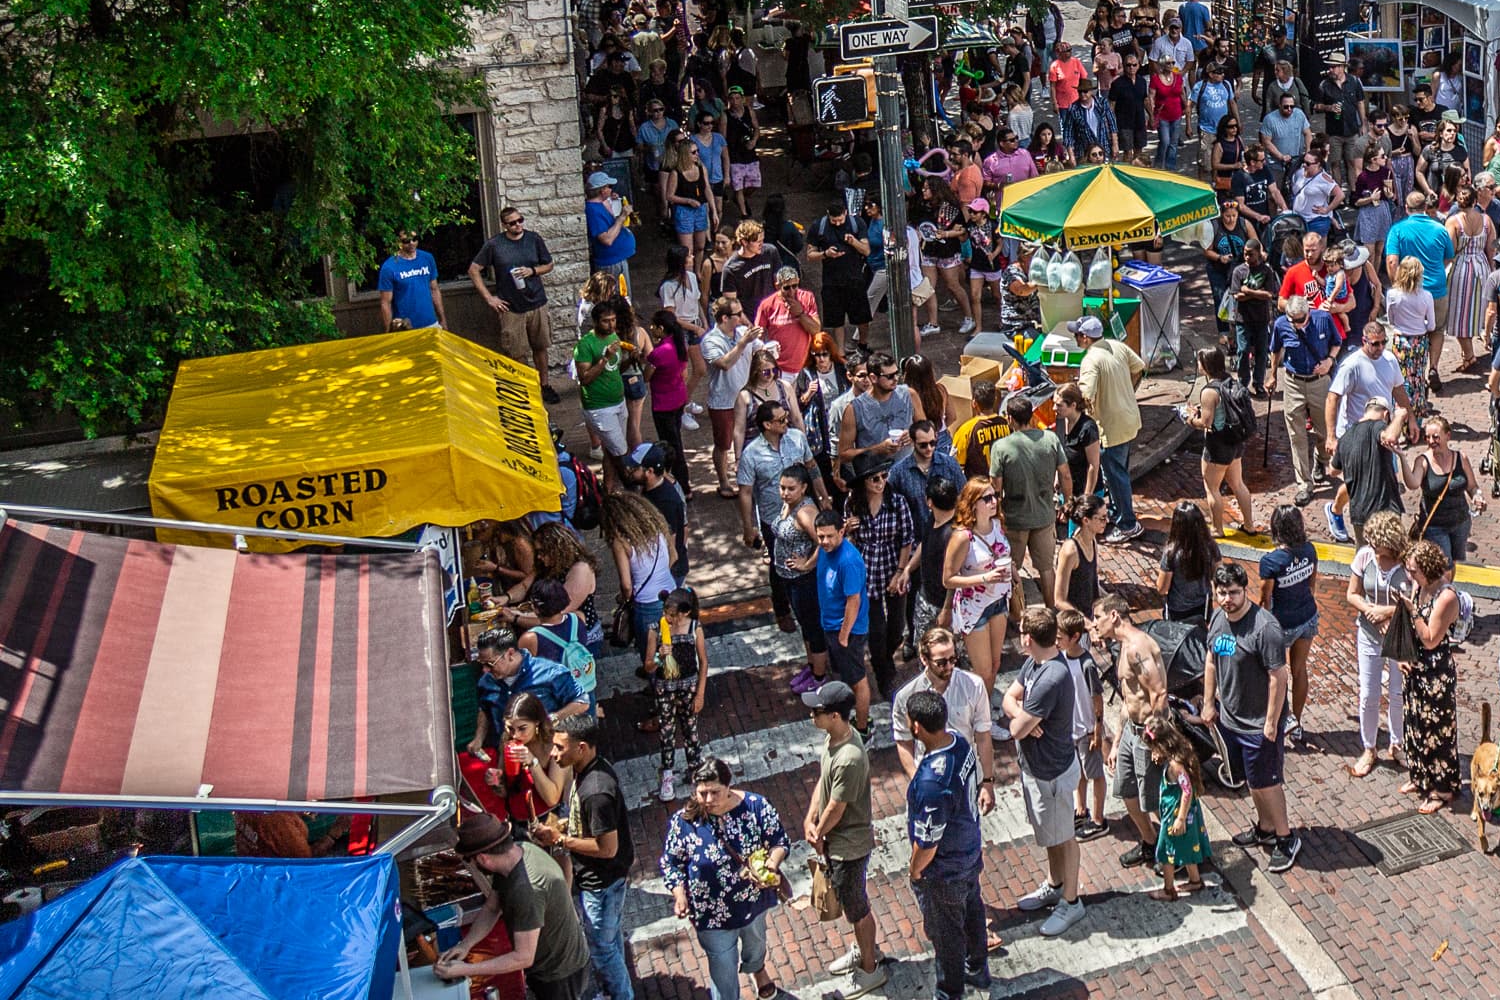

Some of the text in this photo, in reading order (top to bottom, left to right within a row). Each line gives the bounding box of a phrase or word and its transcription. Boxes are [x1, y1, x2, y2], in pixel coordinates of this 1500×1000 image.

[852, 29, 908, 48] ONE WAY
[1158, 204, 1218, 233] LEMONADE
[1069, 226, 1154, 247] LEMONADE
[496, 405, 543, 464] ROASTED
[977, 424, 1012, 444] GWYNN
[215, 469, 388, 512] ROASTED
[255, 500, 355, 531] CORN
[930, 755, 947, 776] 4
